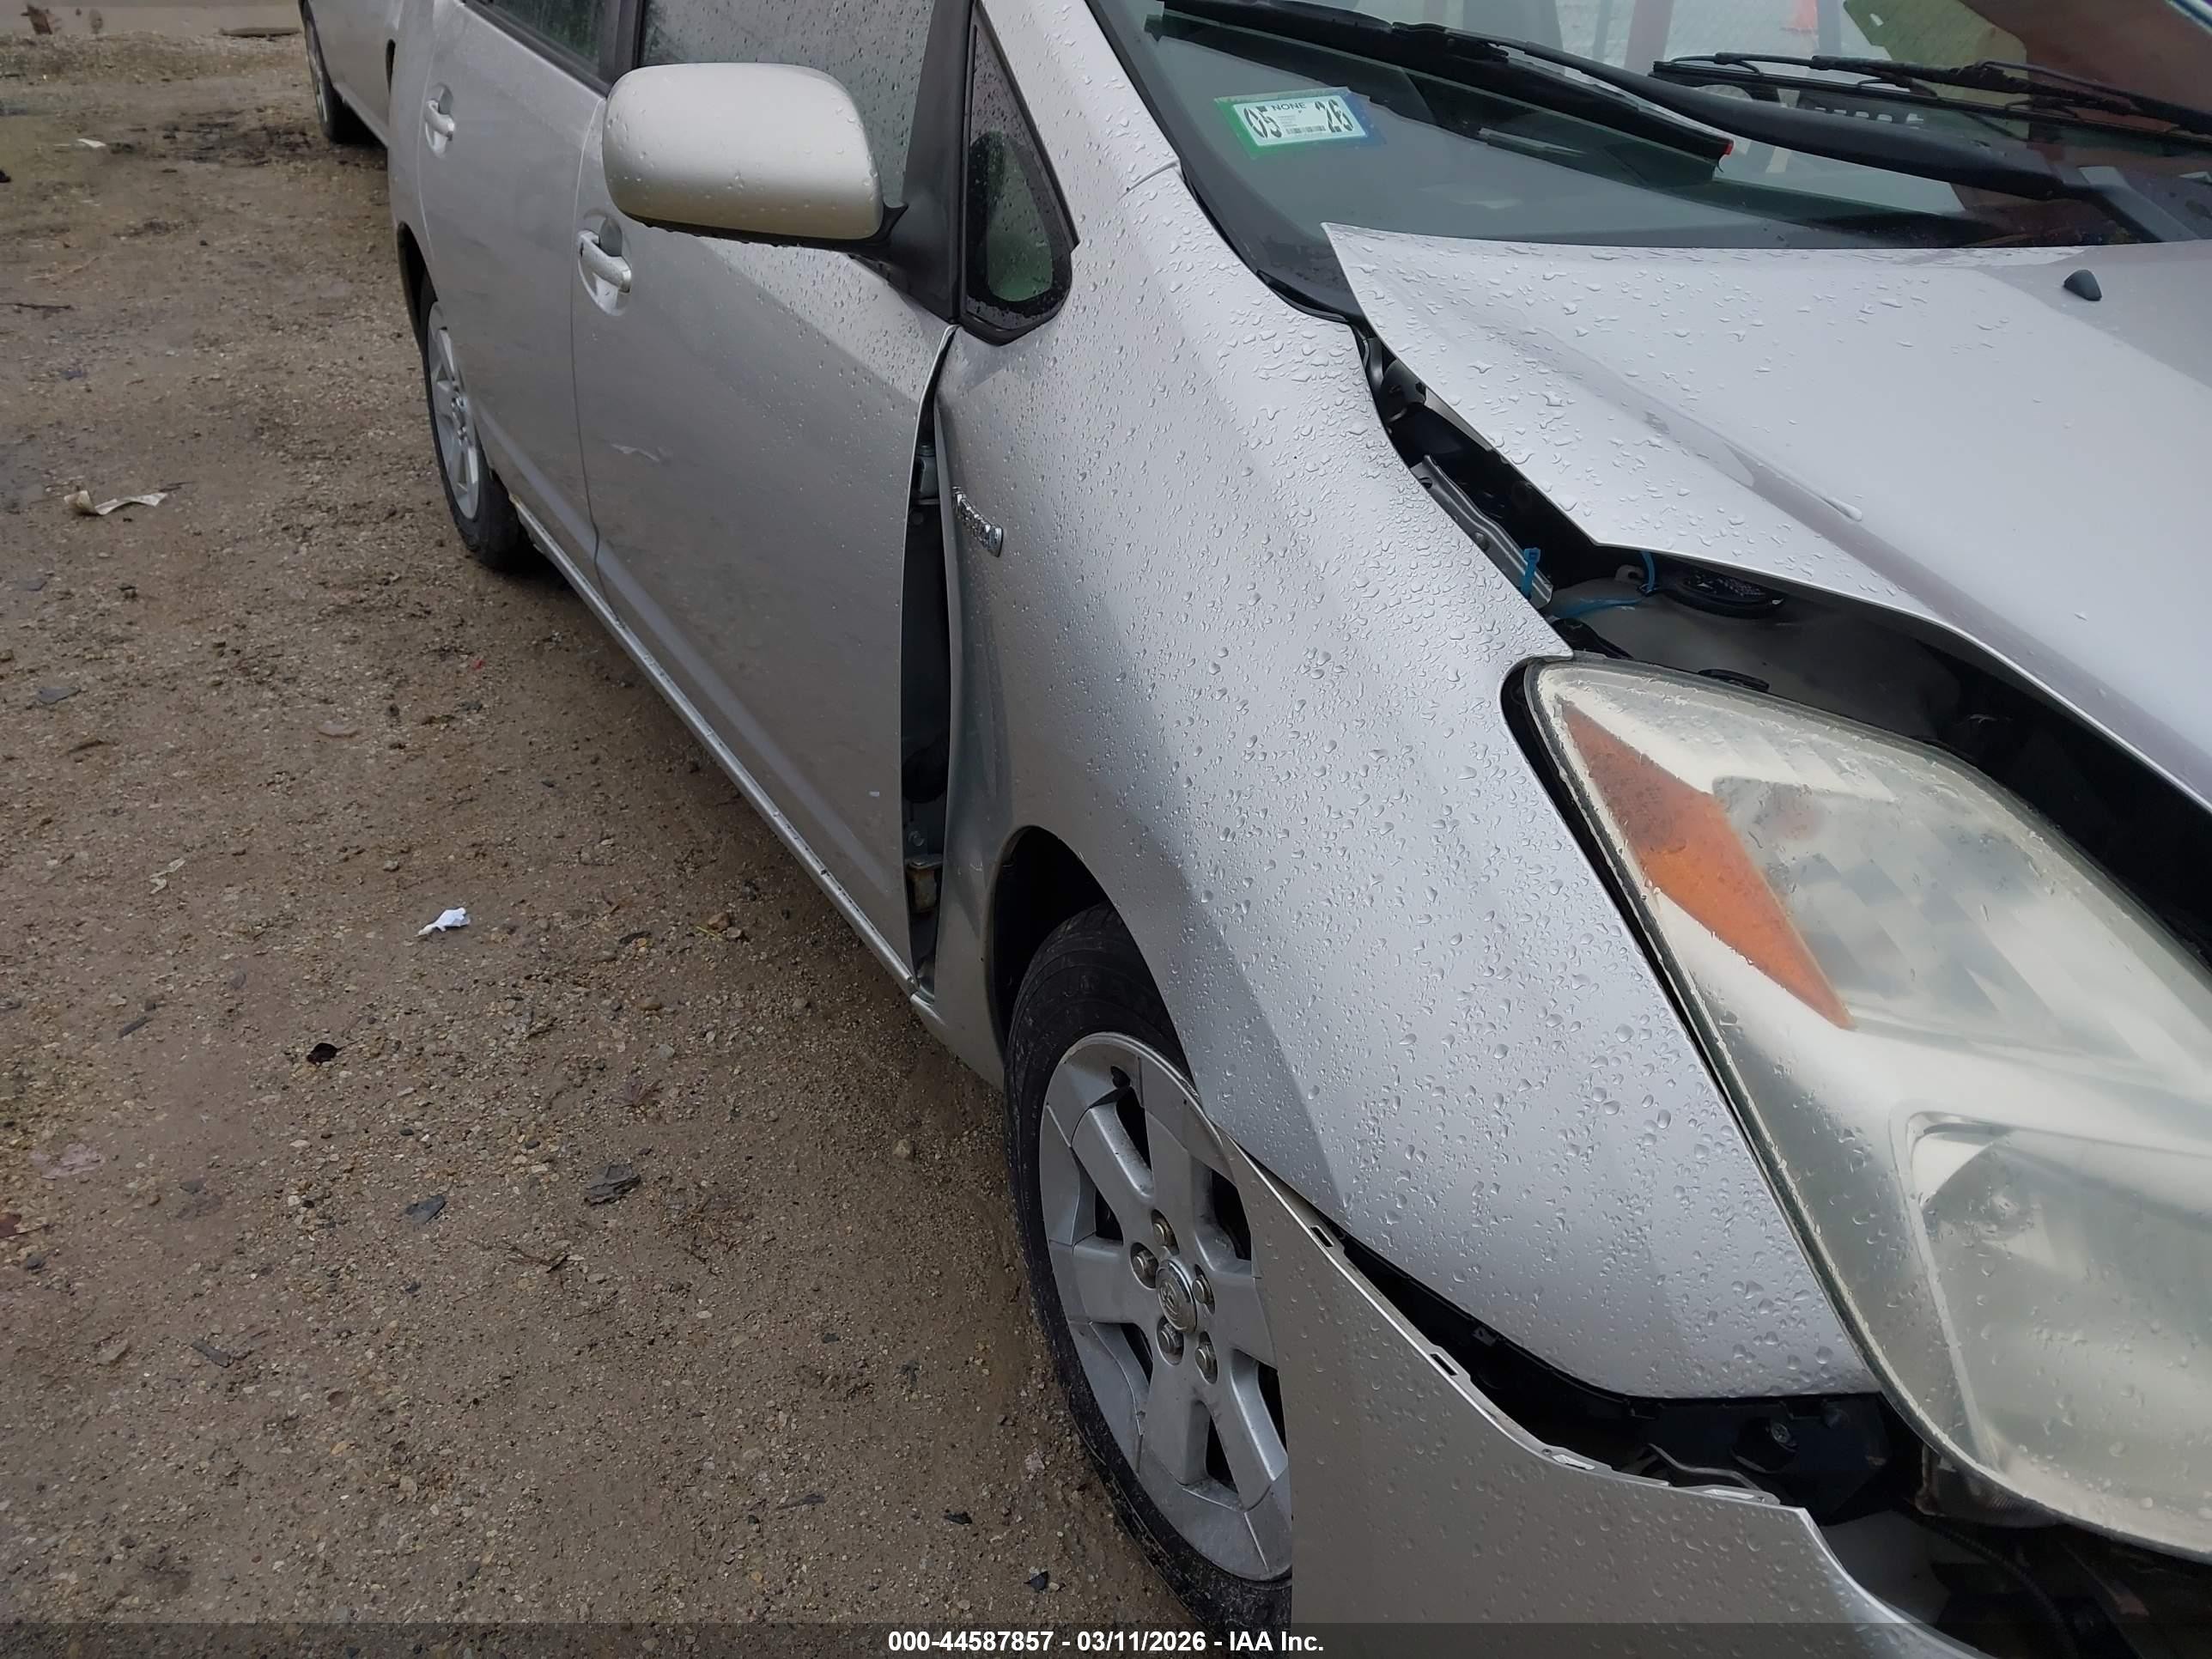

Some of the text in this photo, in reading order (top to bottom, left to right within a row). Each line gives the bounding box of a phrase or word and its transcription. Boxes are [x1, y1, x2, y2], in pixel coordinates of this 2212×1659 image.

[1243, 106, 1282, 138] 05
[1270, 101, 1306, 111] NONE
[1315, 99, 1354, 132] 26
